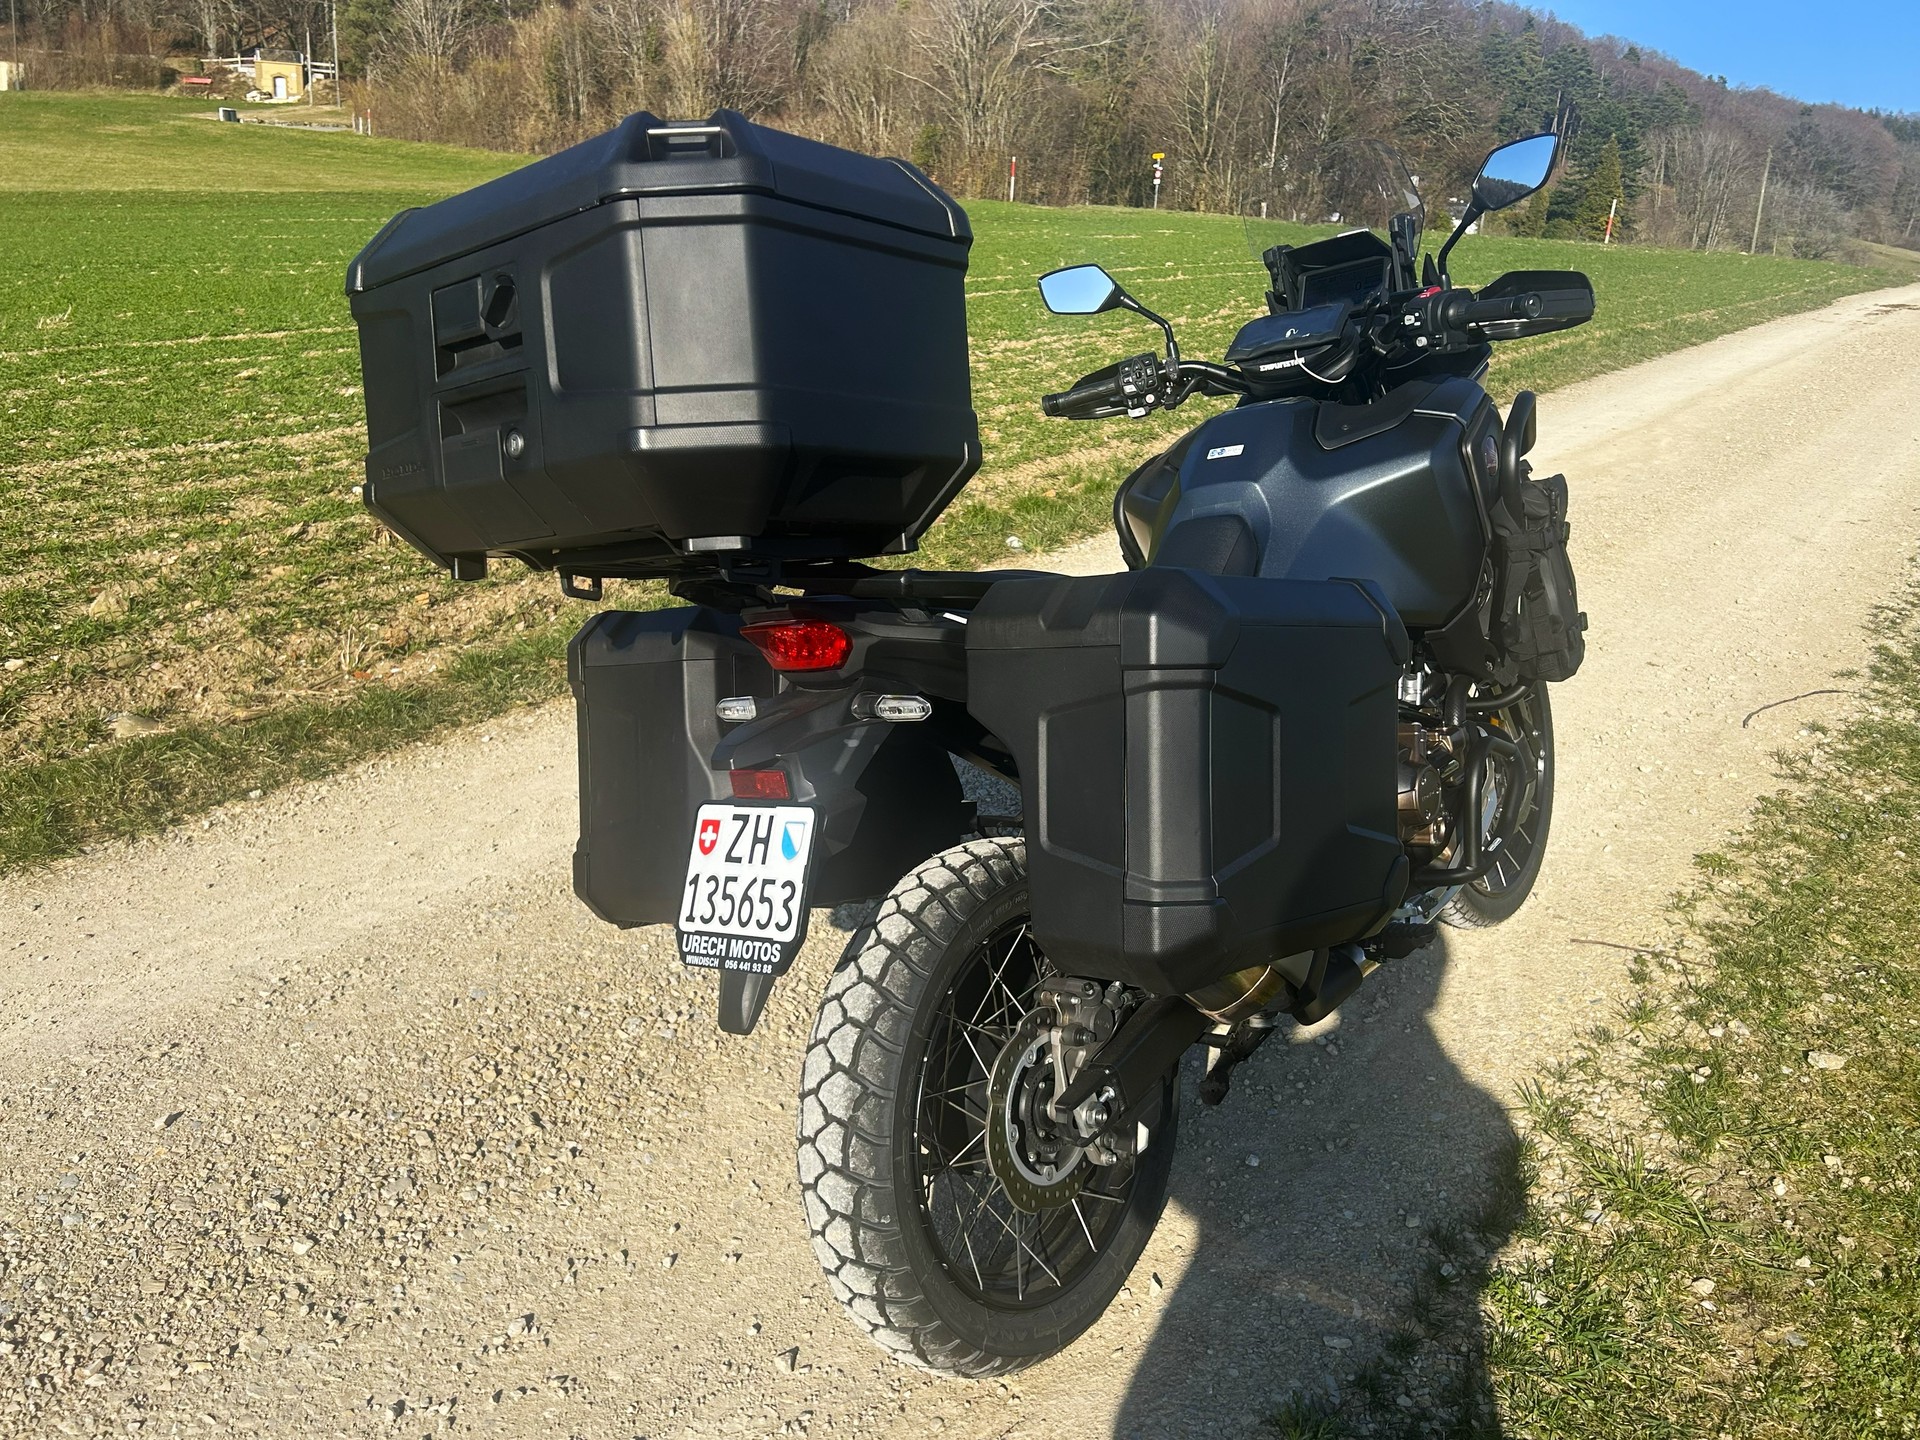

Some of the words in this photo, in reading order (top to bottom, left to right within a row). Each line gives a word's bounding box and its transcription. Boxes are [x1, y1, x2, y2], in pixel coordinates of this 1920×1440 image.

[724, 813, 775, 865] ZH
[685, 873, 797, 932] 135653
[682, 933, 727, 957] URECH
[729, 939, 782, 963] MOTOS
[686, 954, 719, 968] WINDISCH
[725, 959, 738, 970] 056
[739, 961, 751, 971] 441
[752, 963, 762, 973] 93
[762, 964, 773, 974] 88
